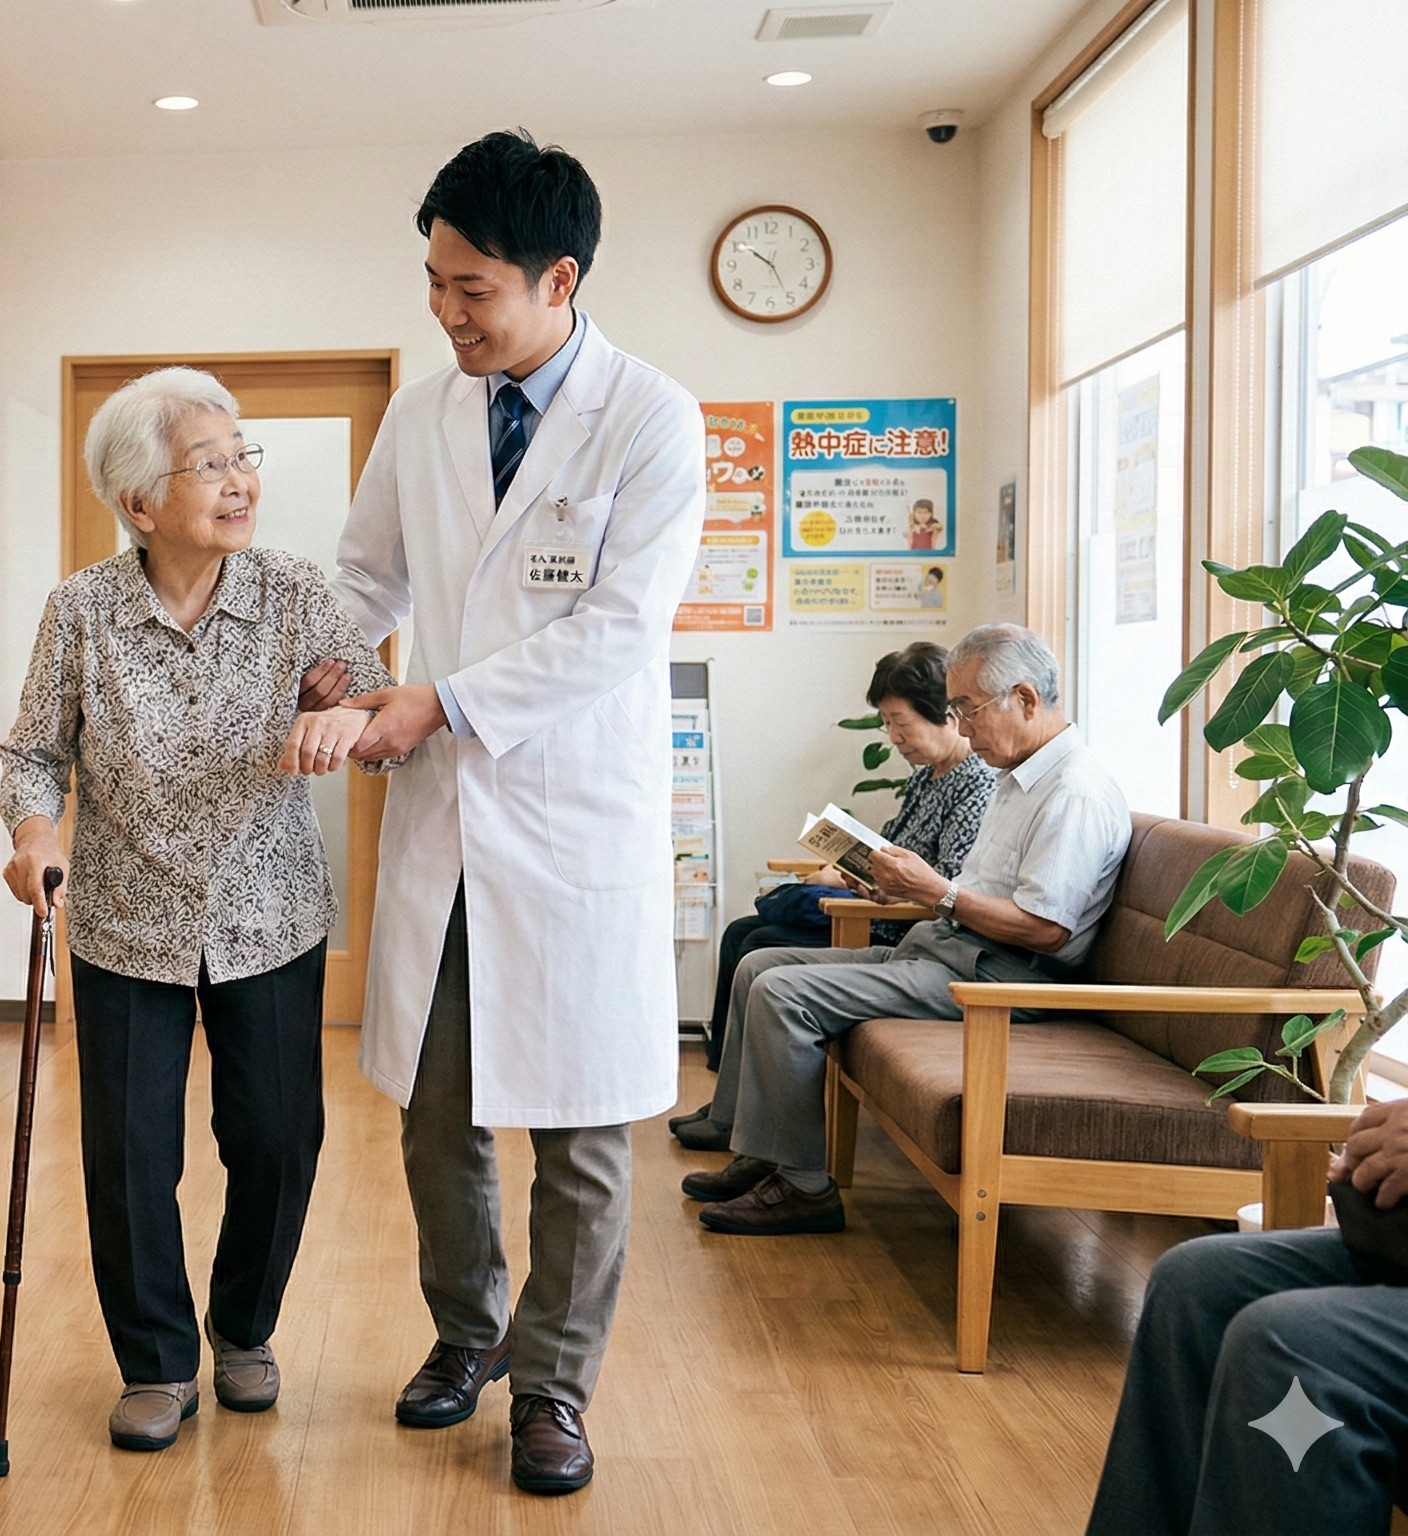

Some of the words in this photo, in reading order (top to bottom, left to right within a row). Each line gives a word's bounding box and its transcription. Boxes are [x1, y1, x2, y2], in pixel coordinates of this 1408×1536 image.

[747, 226, 758, 239] 11
[764, 221, 778, 235] 12
[800, 238, 809, 252] 2
[726, 260, 737, 273] 9
[805, 258, 815, 271] 3
[733, 278, 743, 291] 8
[799, 276, 808, 289] 4
[747, 292, 756, 305] 7
[765, 296, 775, 310] 6
[786, 292, 795, 305] 5
[791, 429, 948, 457] 熱中症に注意!
